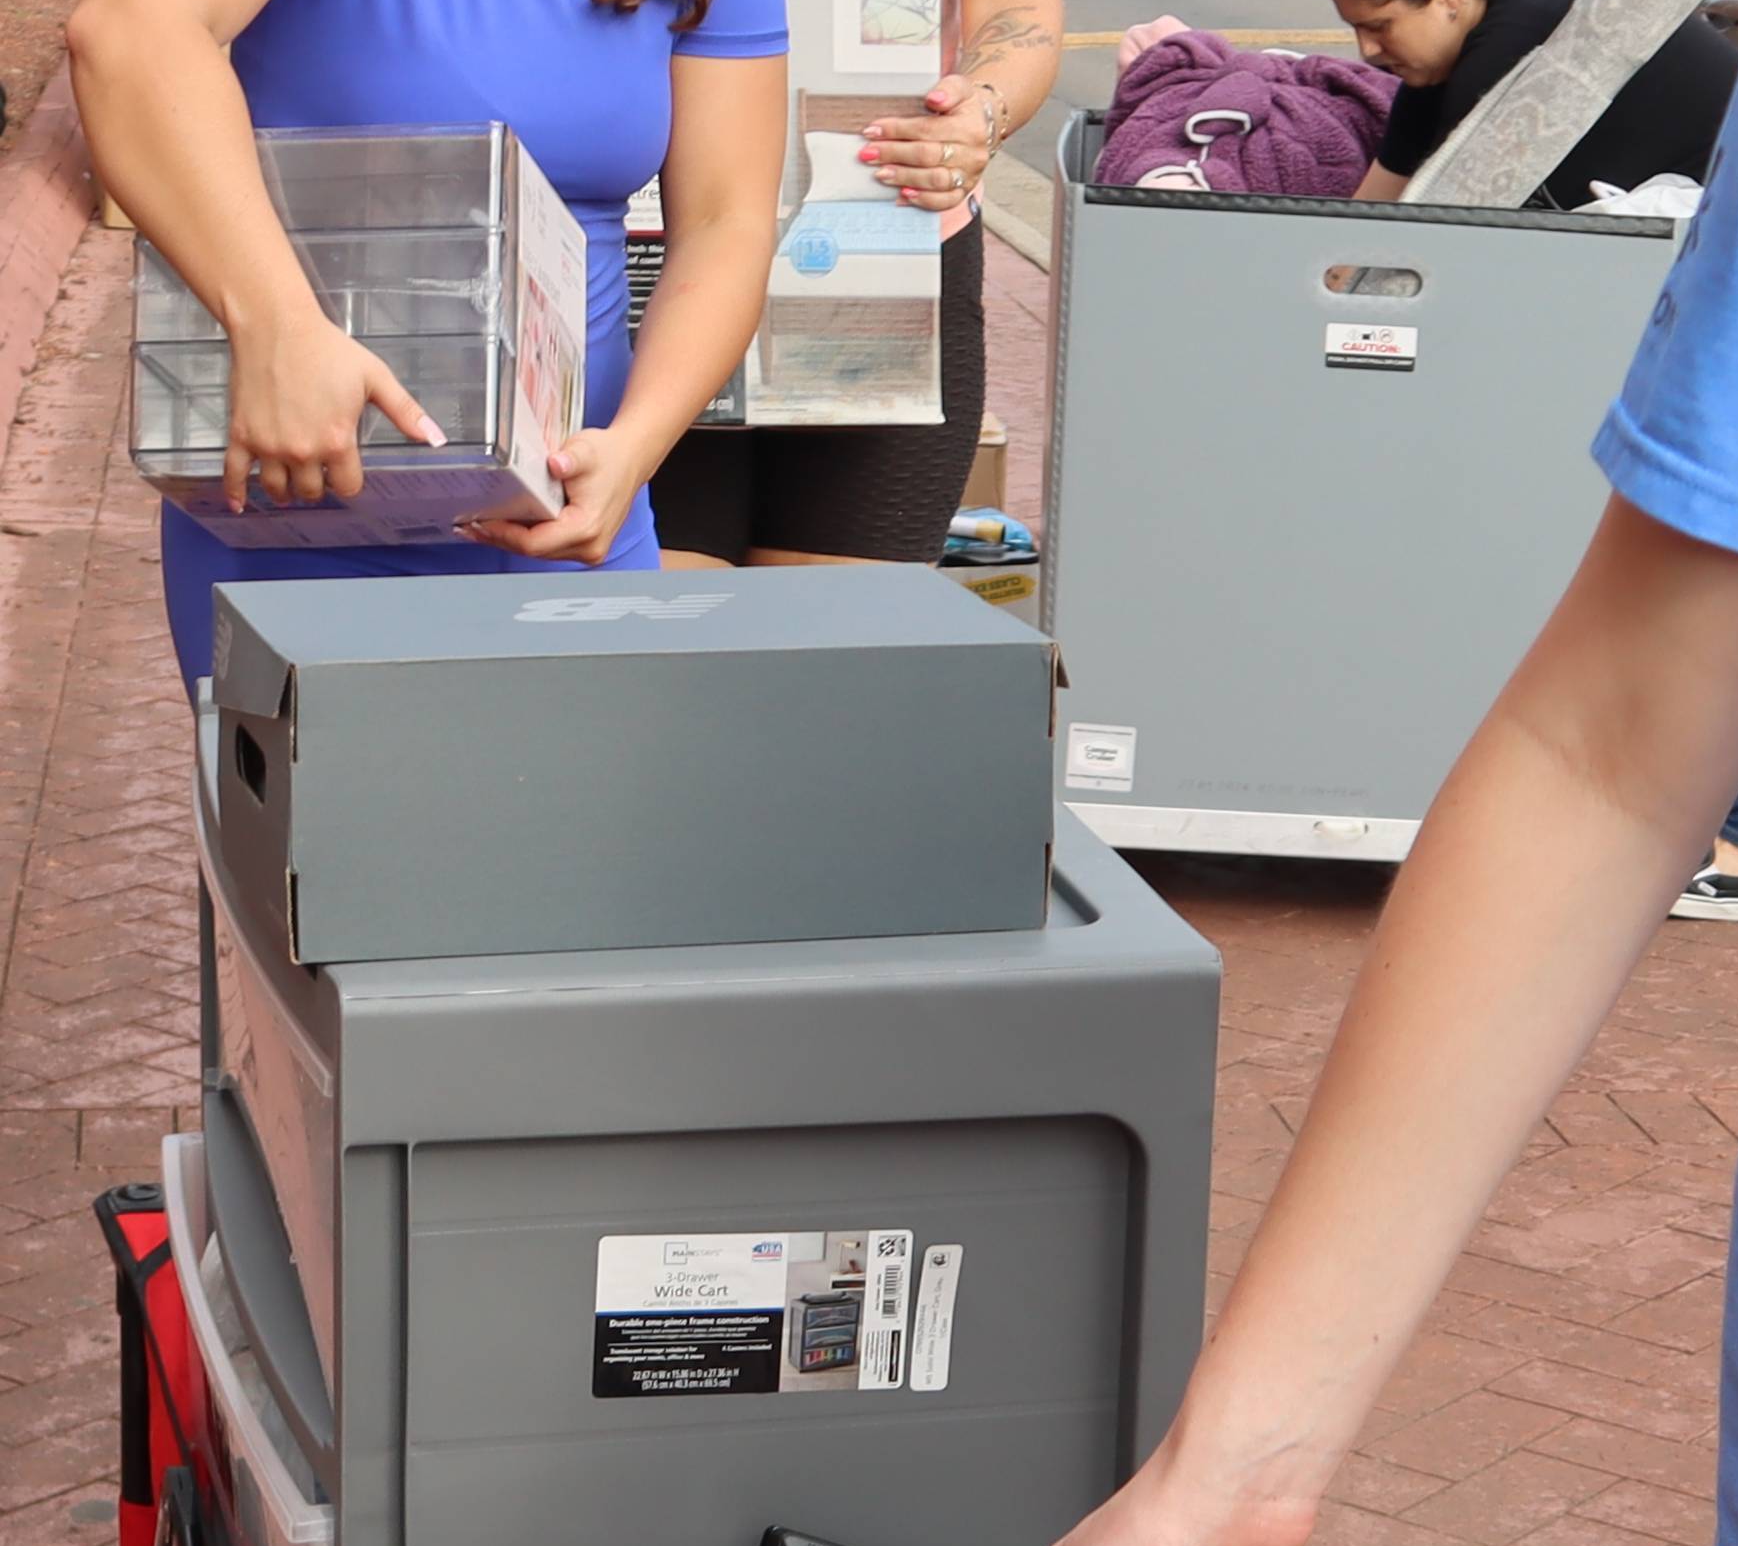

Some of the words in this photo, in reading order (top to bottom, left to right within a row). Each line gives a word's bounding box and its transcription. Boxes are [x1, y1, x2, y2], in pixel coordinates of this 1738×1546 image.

[666, 1271, 720, 1284] 3-Drawer
[654, 1284, 694, 1298] Wide
[697, 1284, 729, 1297] Cart
[608, 1318, 644, 1328] Durable
[645, 1317, 688, 1328] one-piece
[689, 1316, 715, 1326] frame
[716, 1315, 770, 1325] construction
